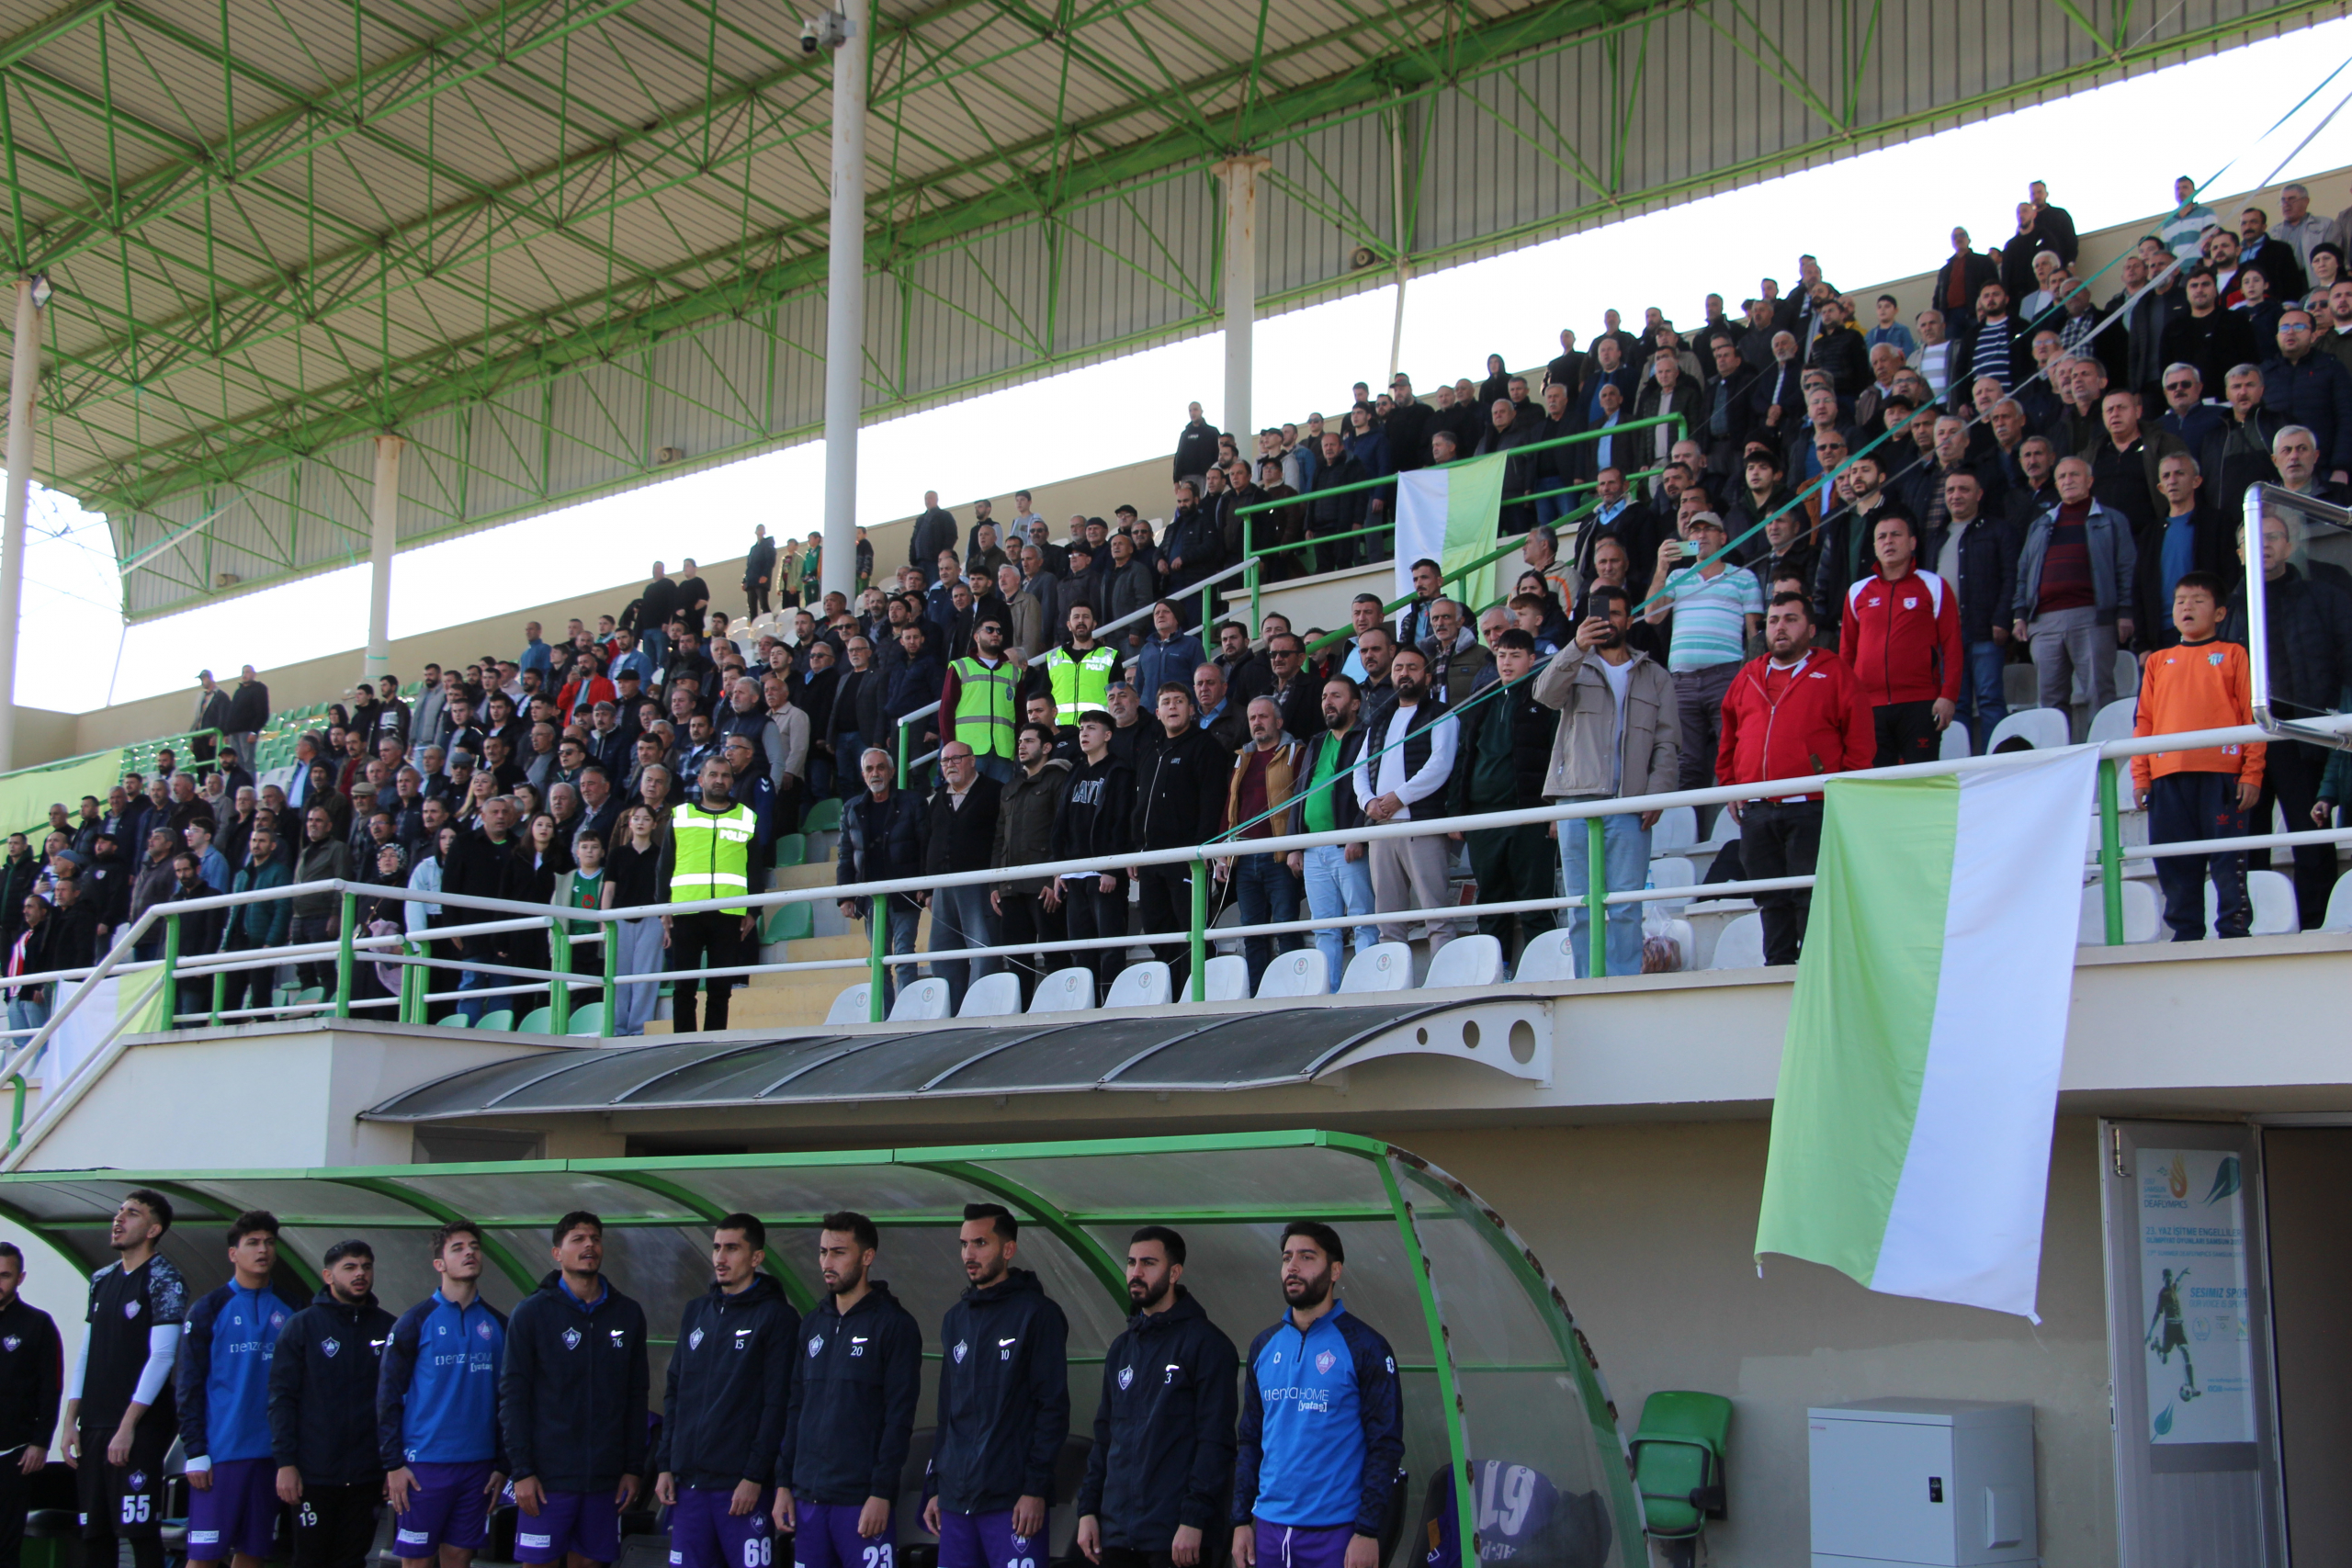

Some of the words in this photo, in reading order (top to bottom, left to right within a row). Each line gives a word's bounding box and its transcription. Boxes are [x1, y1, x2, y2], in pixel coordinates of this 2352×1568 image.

[2143, 1199, 2188, 1209] DEAFLYMPICS
[2158, 1226, 2172, 1235] YAZ
[612, 1337, 623, 1348] 76
[735, 1339, 745, 1349] 15
[851, 1346, 864, 1357] 20
[1001, 1349, 1010, 1360] 10
[1164, 1372, 1172, 1384] 3
[122, 1495, 151, 1524] 55
[300, 1511, 318, 1527] 19
[744, 1537, 772, 1568] 68
[864, 1543, 893, 1568] 23
